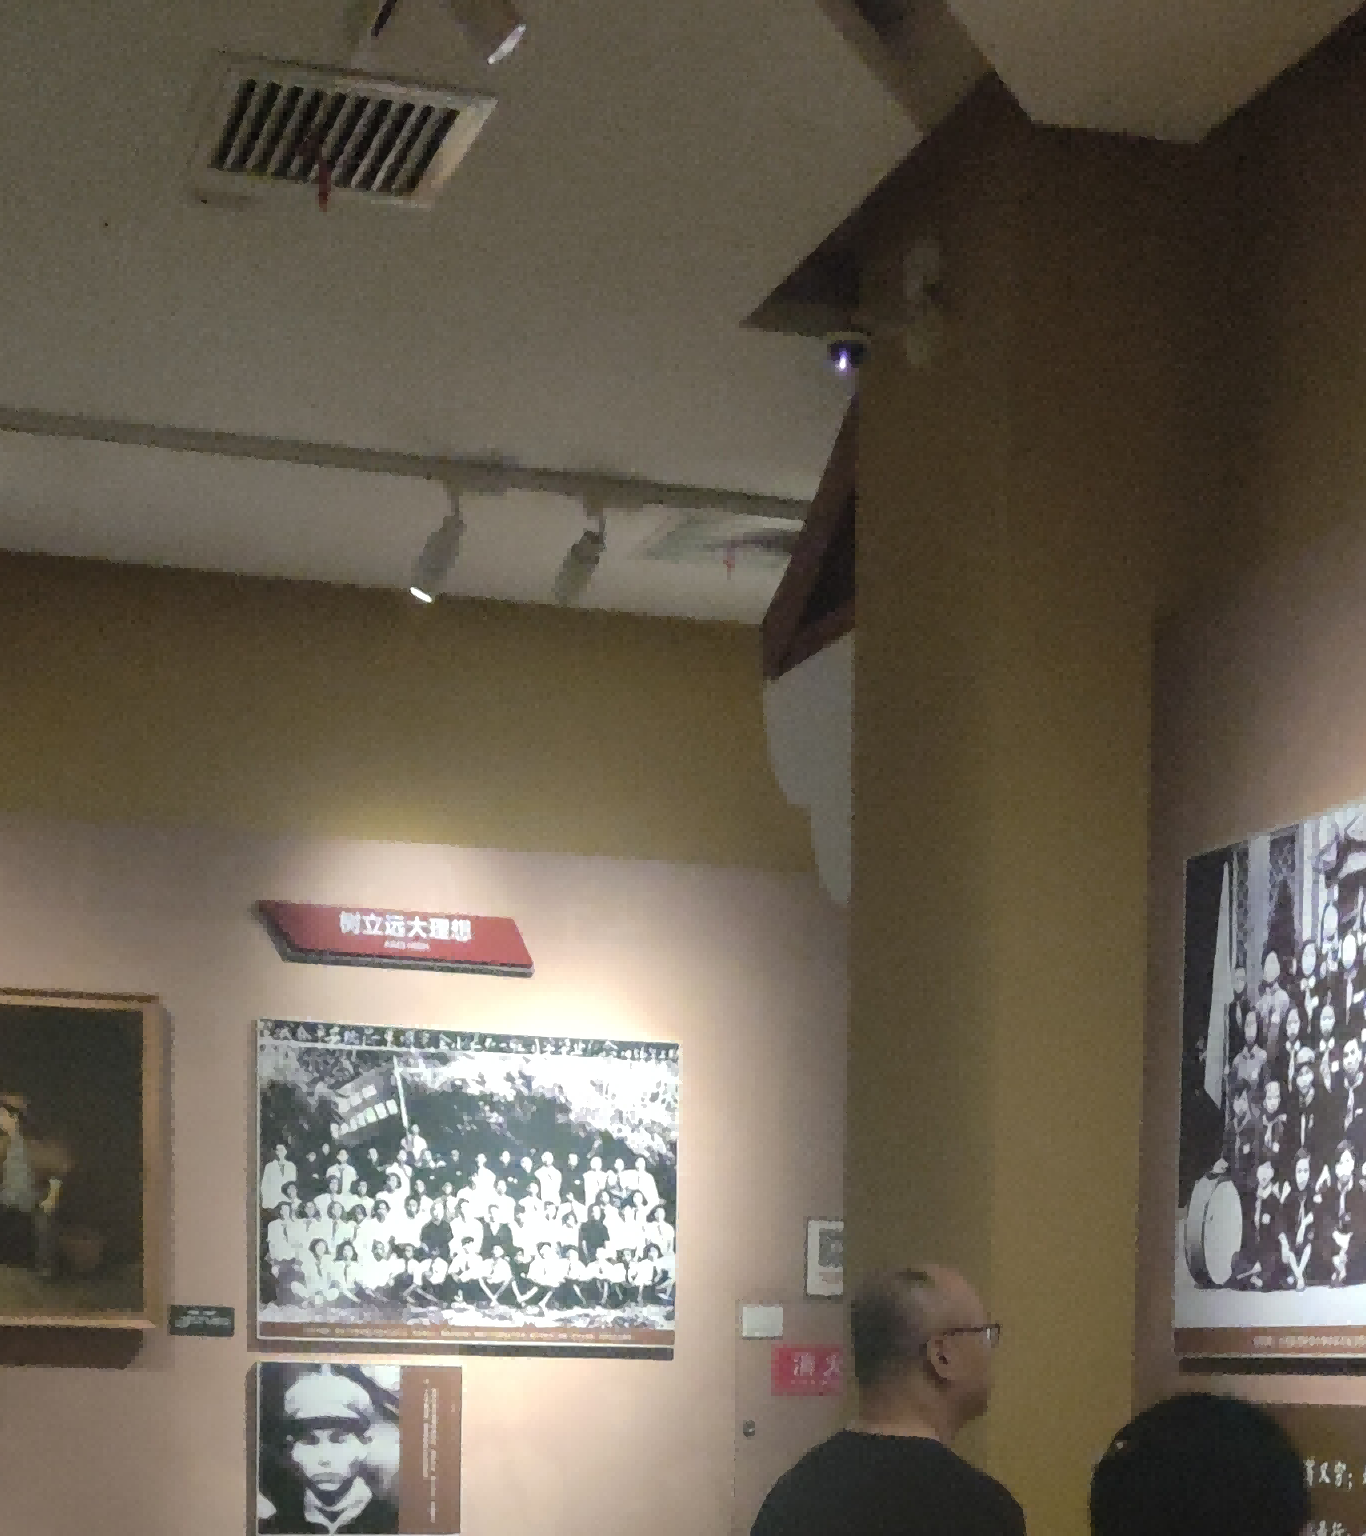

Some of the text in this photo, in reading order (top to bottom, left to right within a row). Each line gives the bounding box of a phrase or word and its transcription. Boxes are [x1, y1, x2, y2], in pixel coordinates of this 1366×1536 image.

[339, 911, 472, 942] 树立远大理想
